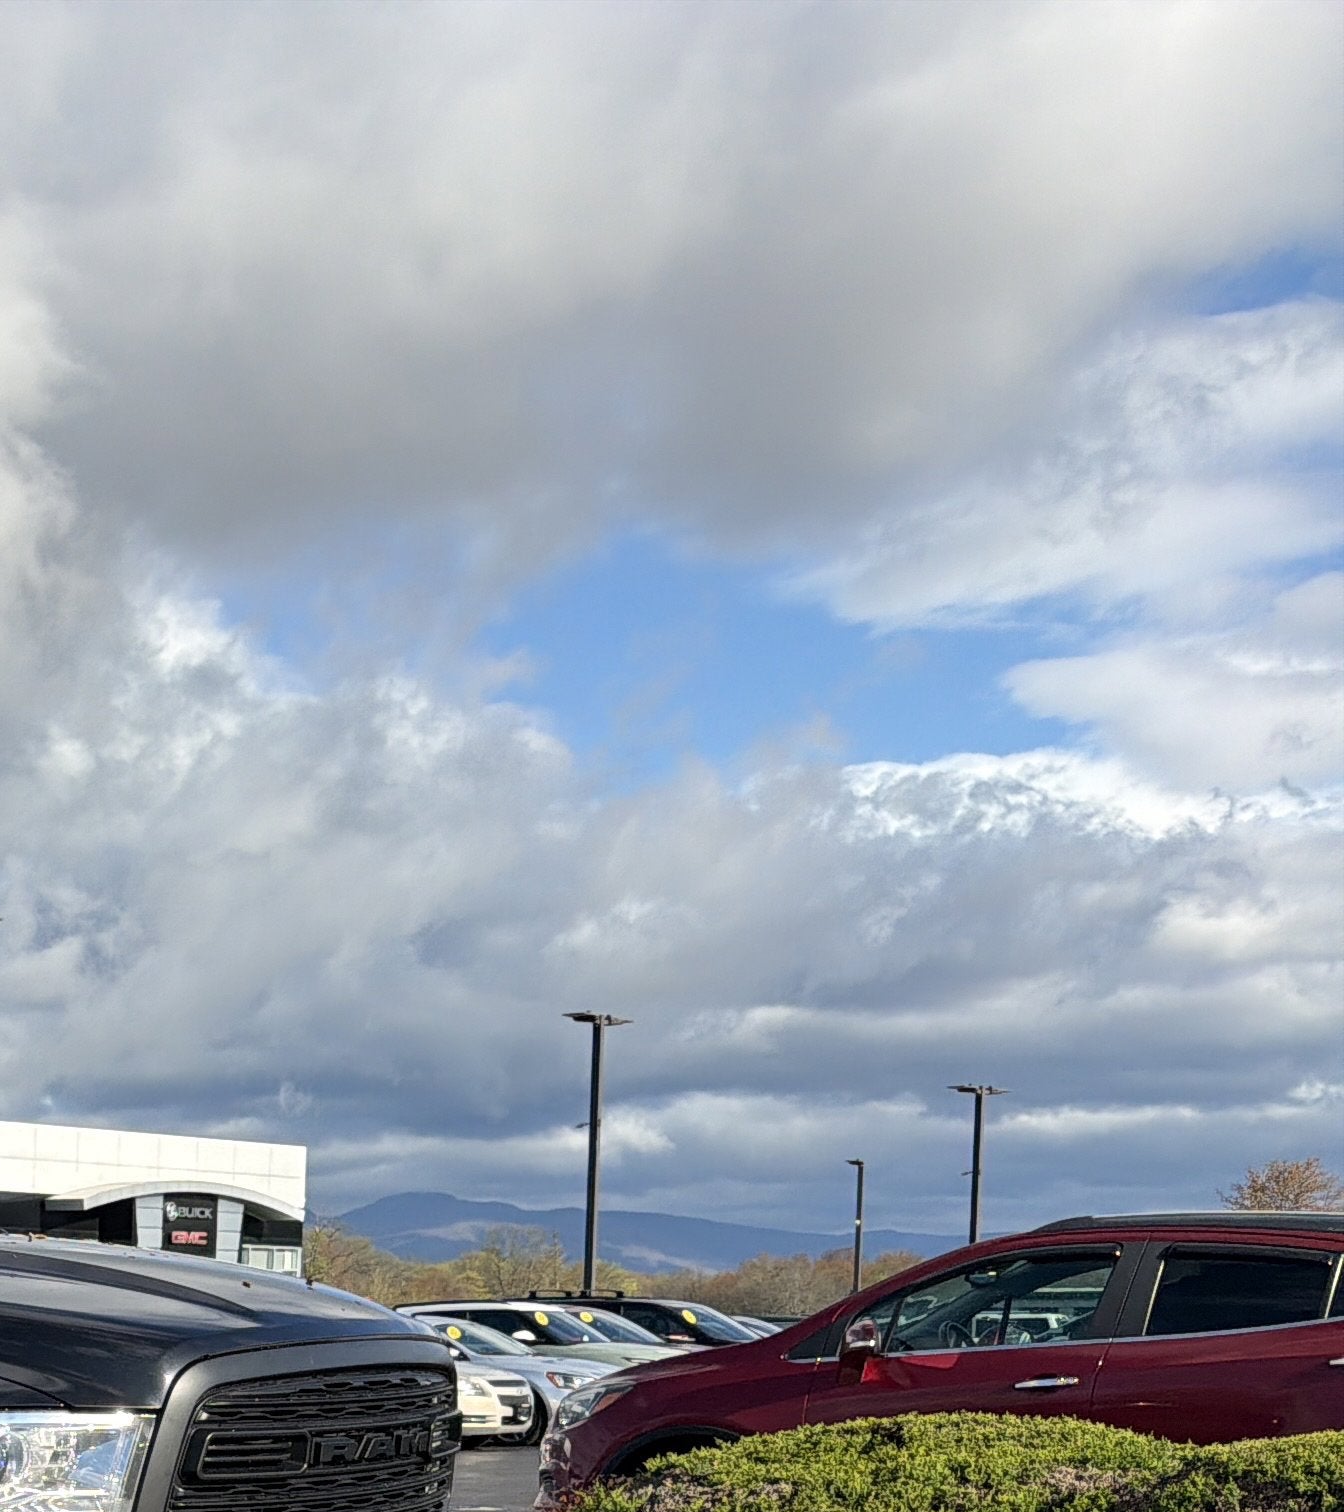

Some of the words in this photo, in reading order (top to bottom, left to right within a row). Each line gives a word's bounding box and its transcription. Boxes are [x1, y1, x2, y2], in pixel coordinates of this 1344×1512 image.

[177, 1206, 213, 1219] BUICK
[171, 1230, 208, 1246] GMC
[311, 1430, 430, 1465] RAM
